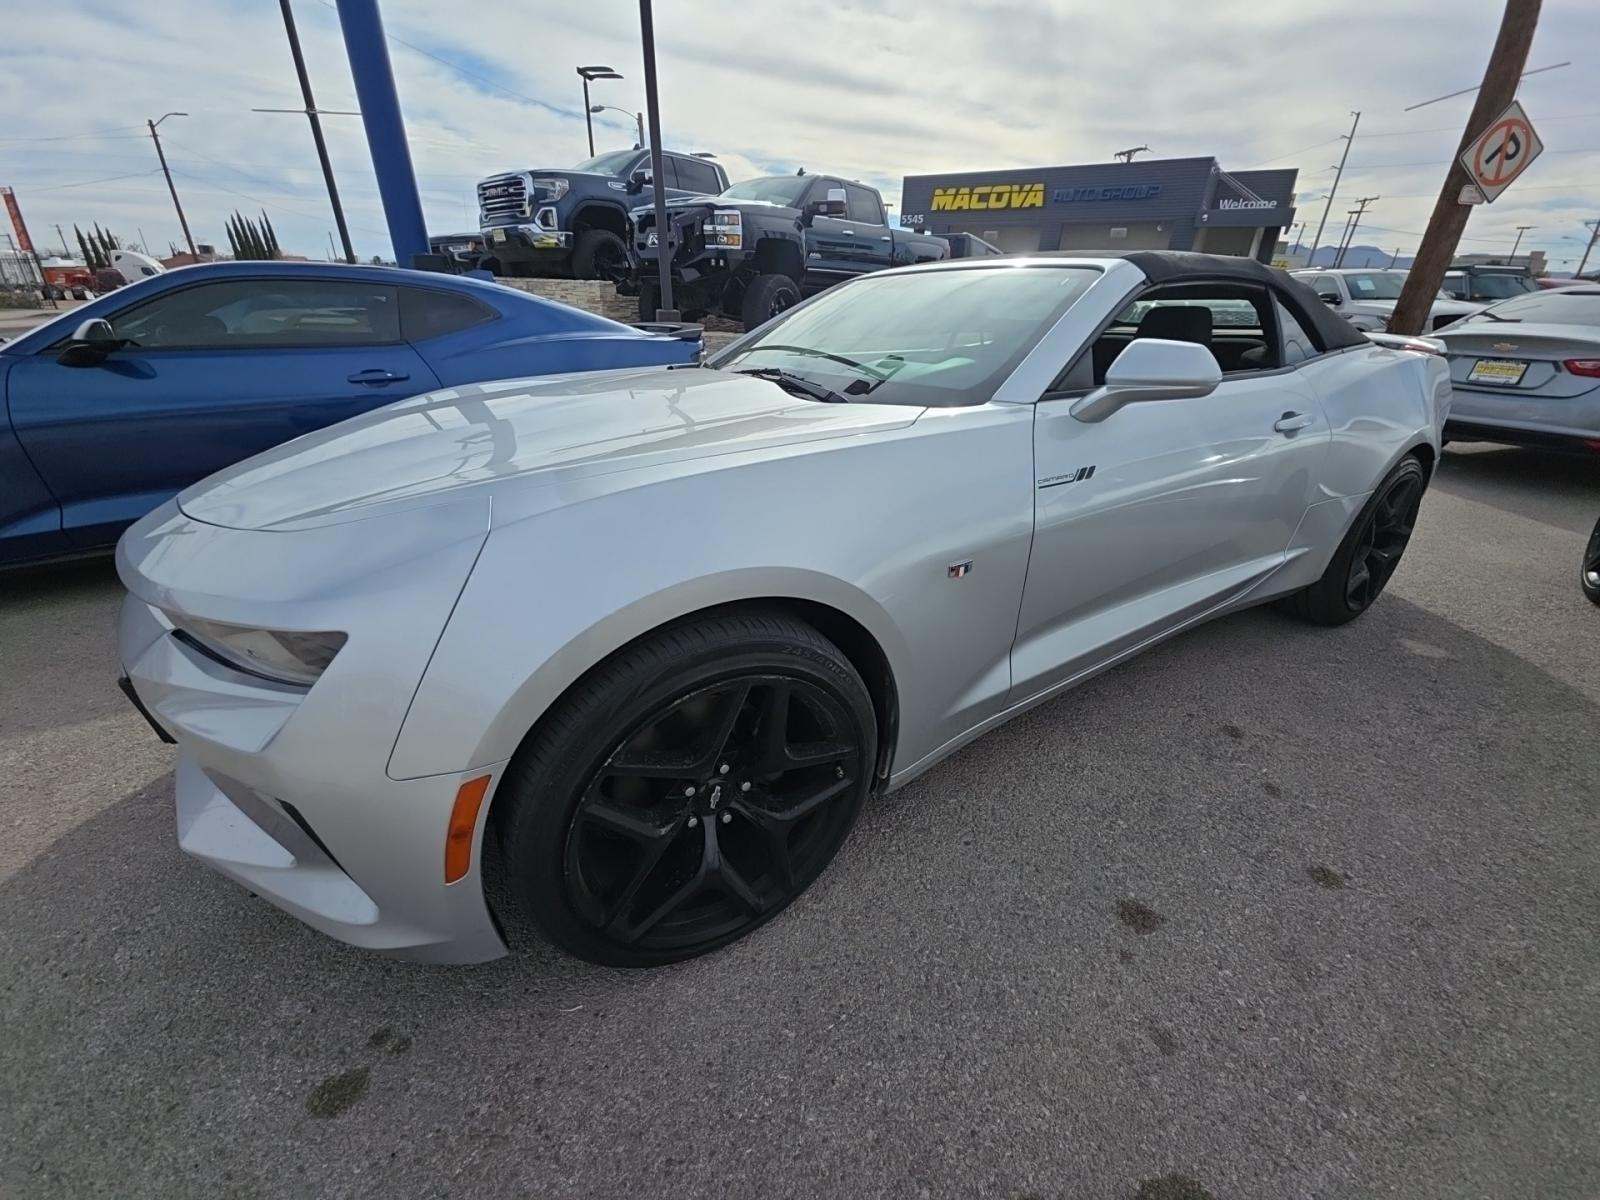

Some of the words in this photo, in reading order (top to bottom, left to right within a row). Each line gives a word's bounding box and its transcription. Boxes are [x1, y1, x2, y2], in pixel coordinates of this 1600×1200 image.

[931, 183, 1045, 211] MACOVA
[1219, 198, 1278, 210] Welcome
[901, 214, 924, 224] 5545
